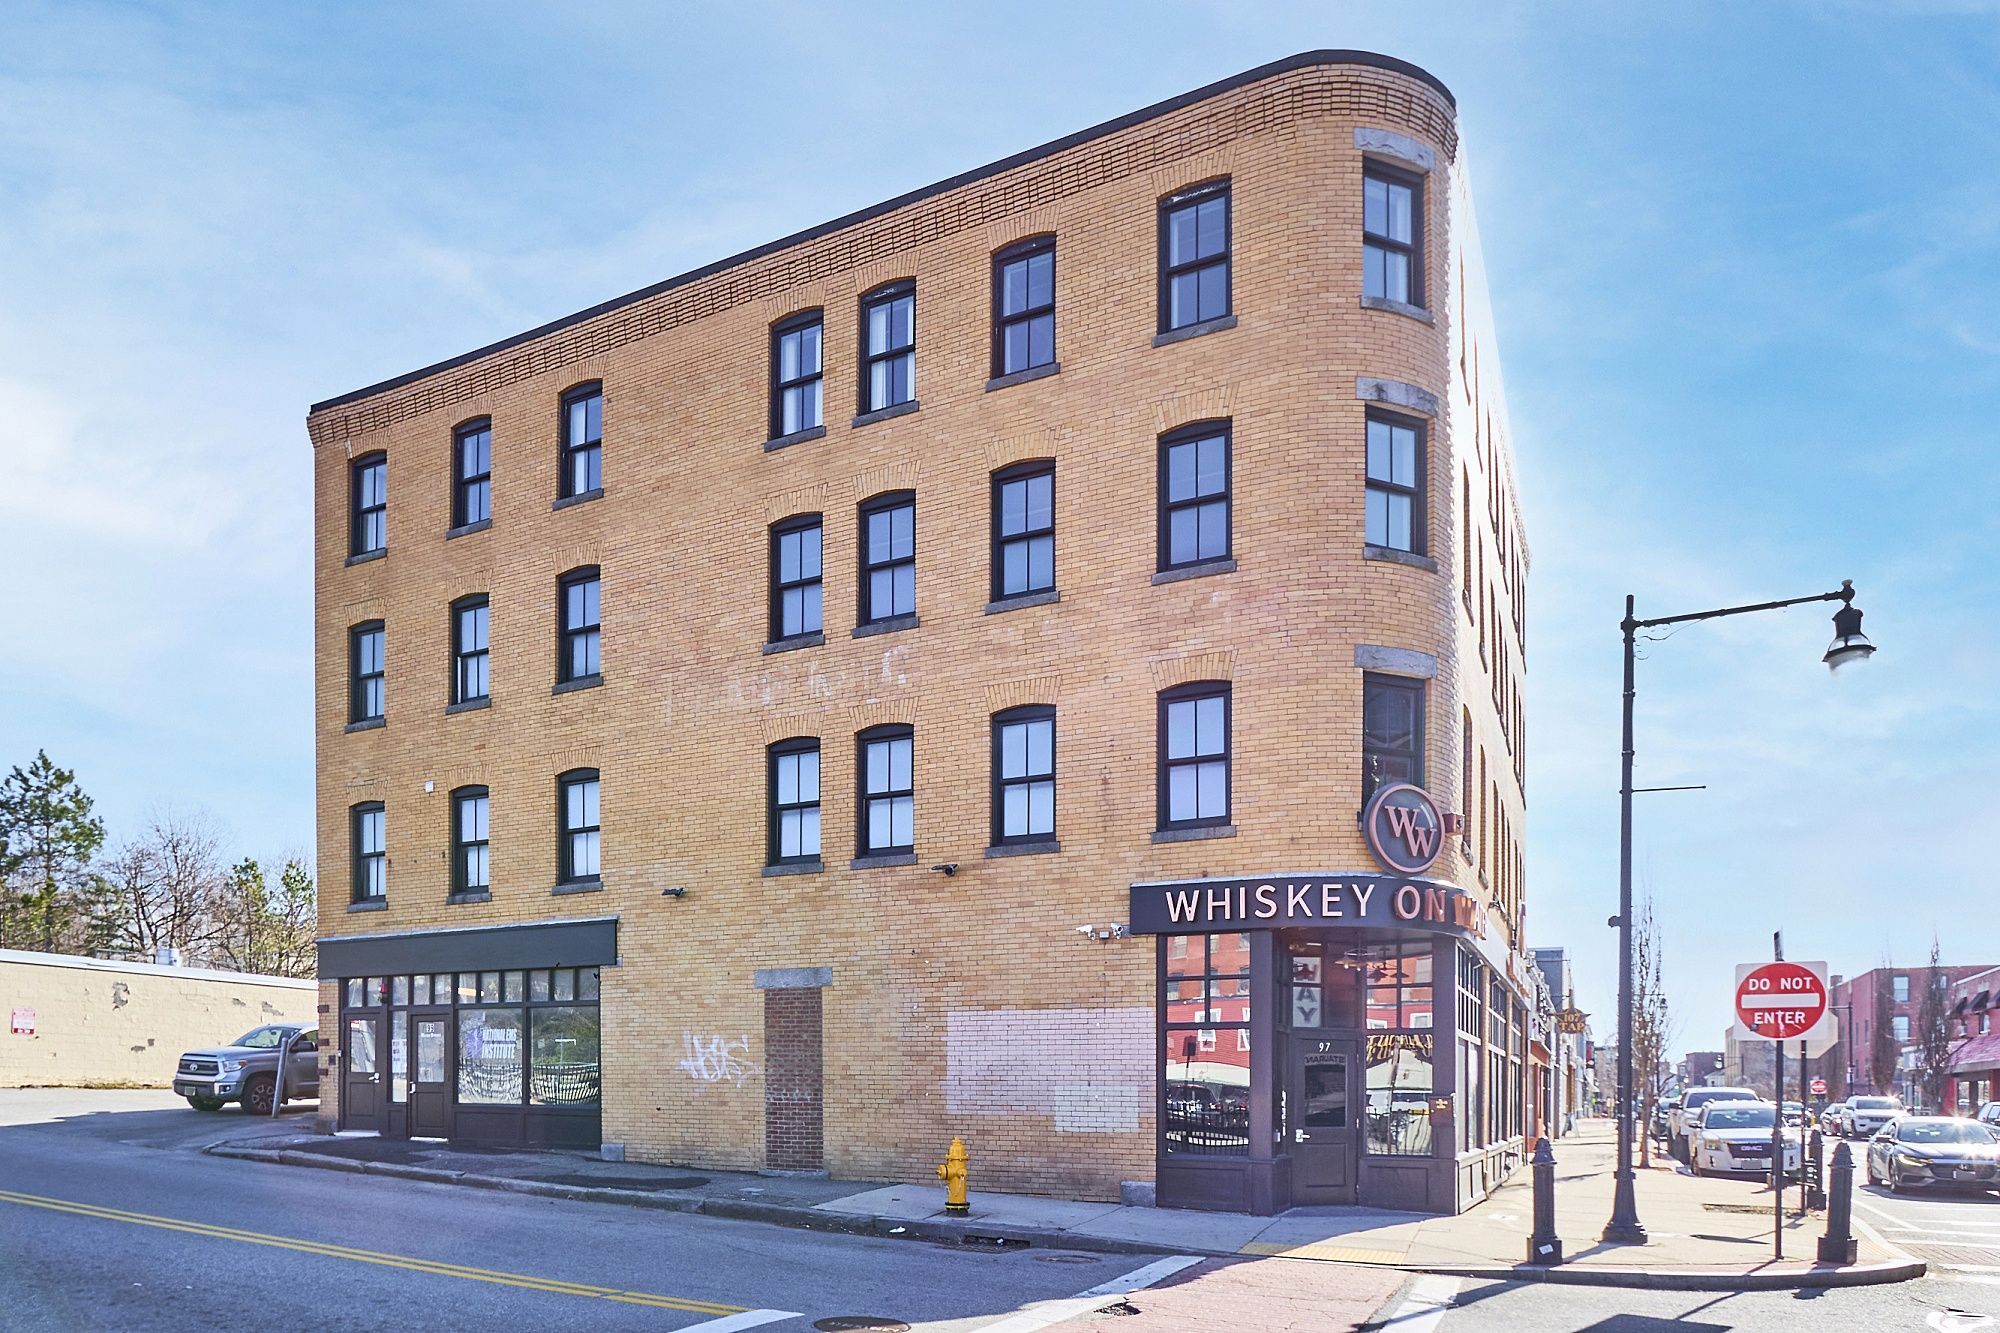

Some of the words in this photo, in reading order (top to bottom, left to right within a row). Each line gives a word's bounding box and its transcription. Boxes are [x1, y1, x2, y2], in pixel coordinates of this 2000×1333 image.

[1165, 883, 1375, 923] WHISKEY
[1395, 885, 1447, 923] ON
[1748, 978, 1771, 991] DO
[1780, 976, 1813, 990] NOT
[1754, 1011, 1806, 1025] ENTER
[1559, 1022, 1585, 1032] TAP
[481, 1043, 517, 1060] INSTITUTE
[1318, 1041, 1331, 1052] 97
